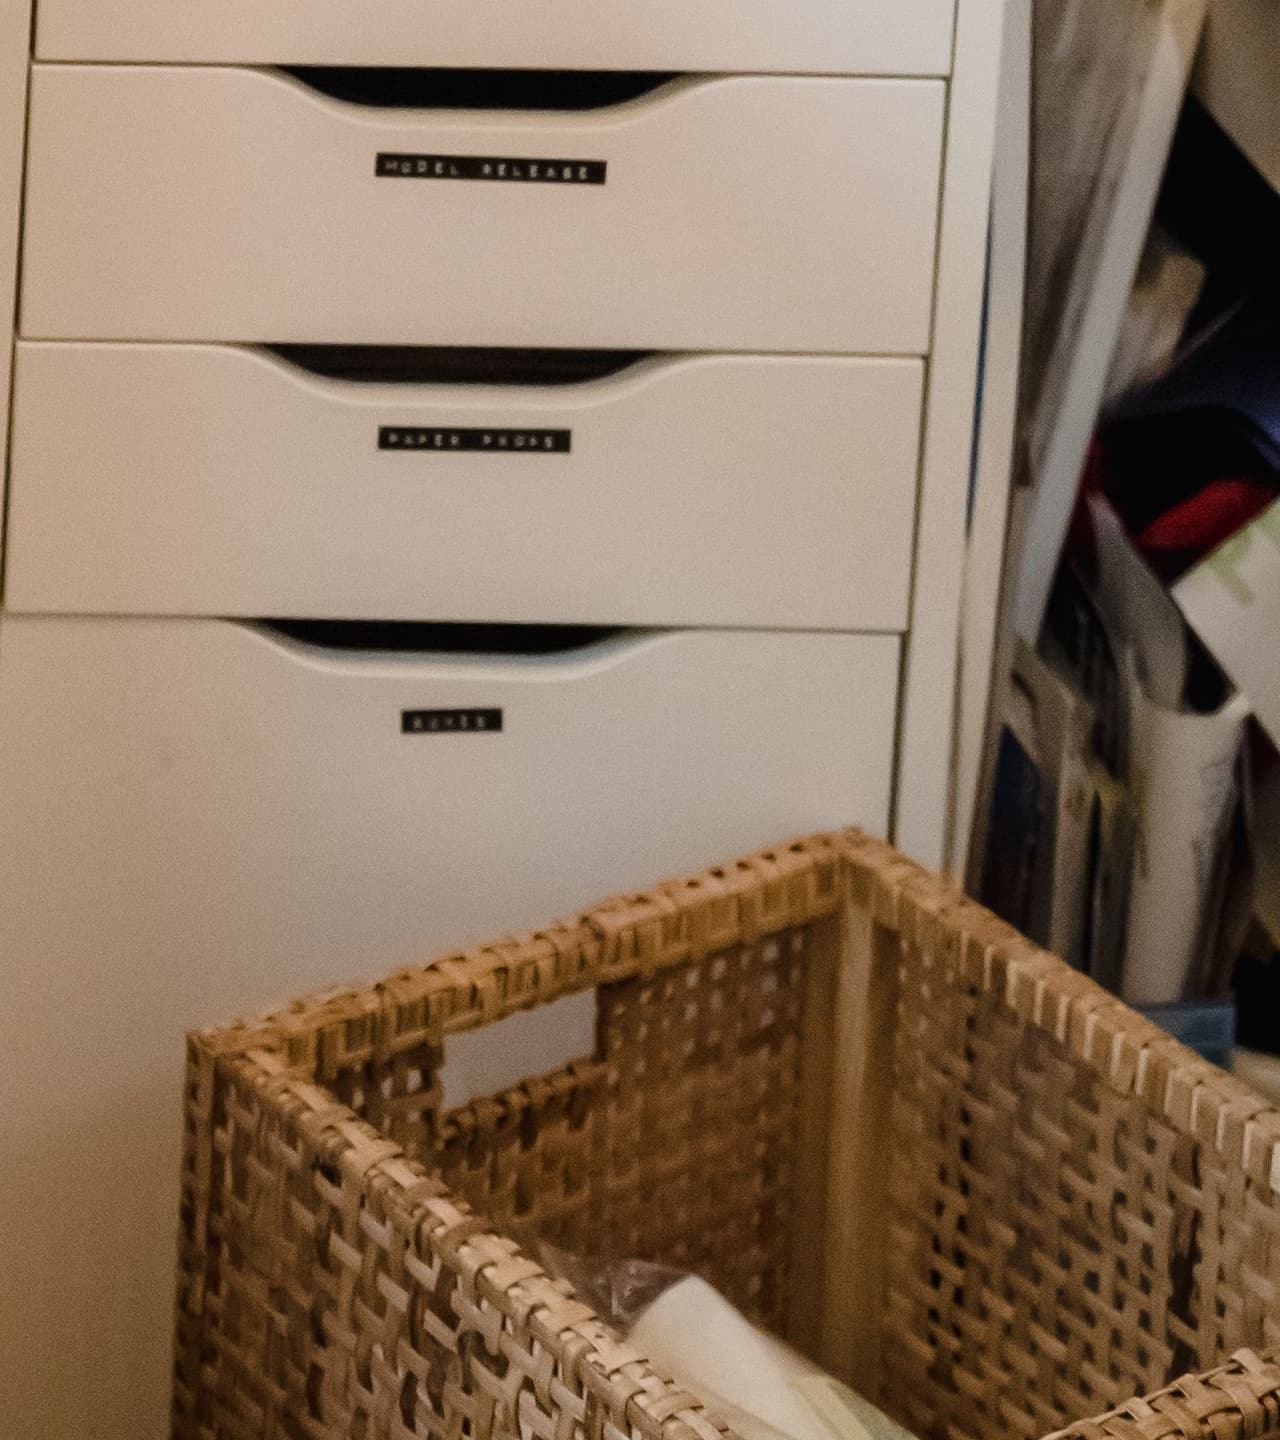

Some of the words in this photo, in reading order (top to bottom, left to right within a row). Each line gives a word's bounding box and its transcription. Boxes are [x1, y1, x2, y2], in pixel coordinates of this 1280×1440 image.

[384, 159, 459, 177] MODEL
[481, 162, 589, 181] RELEASE
[388, 431, 460, 448] PAPER
